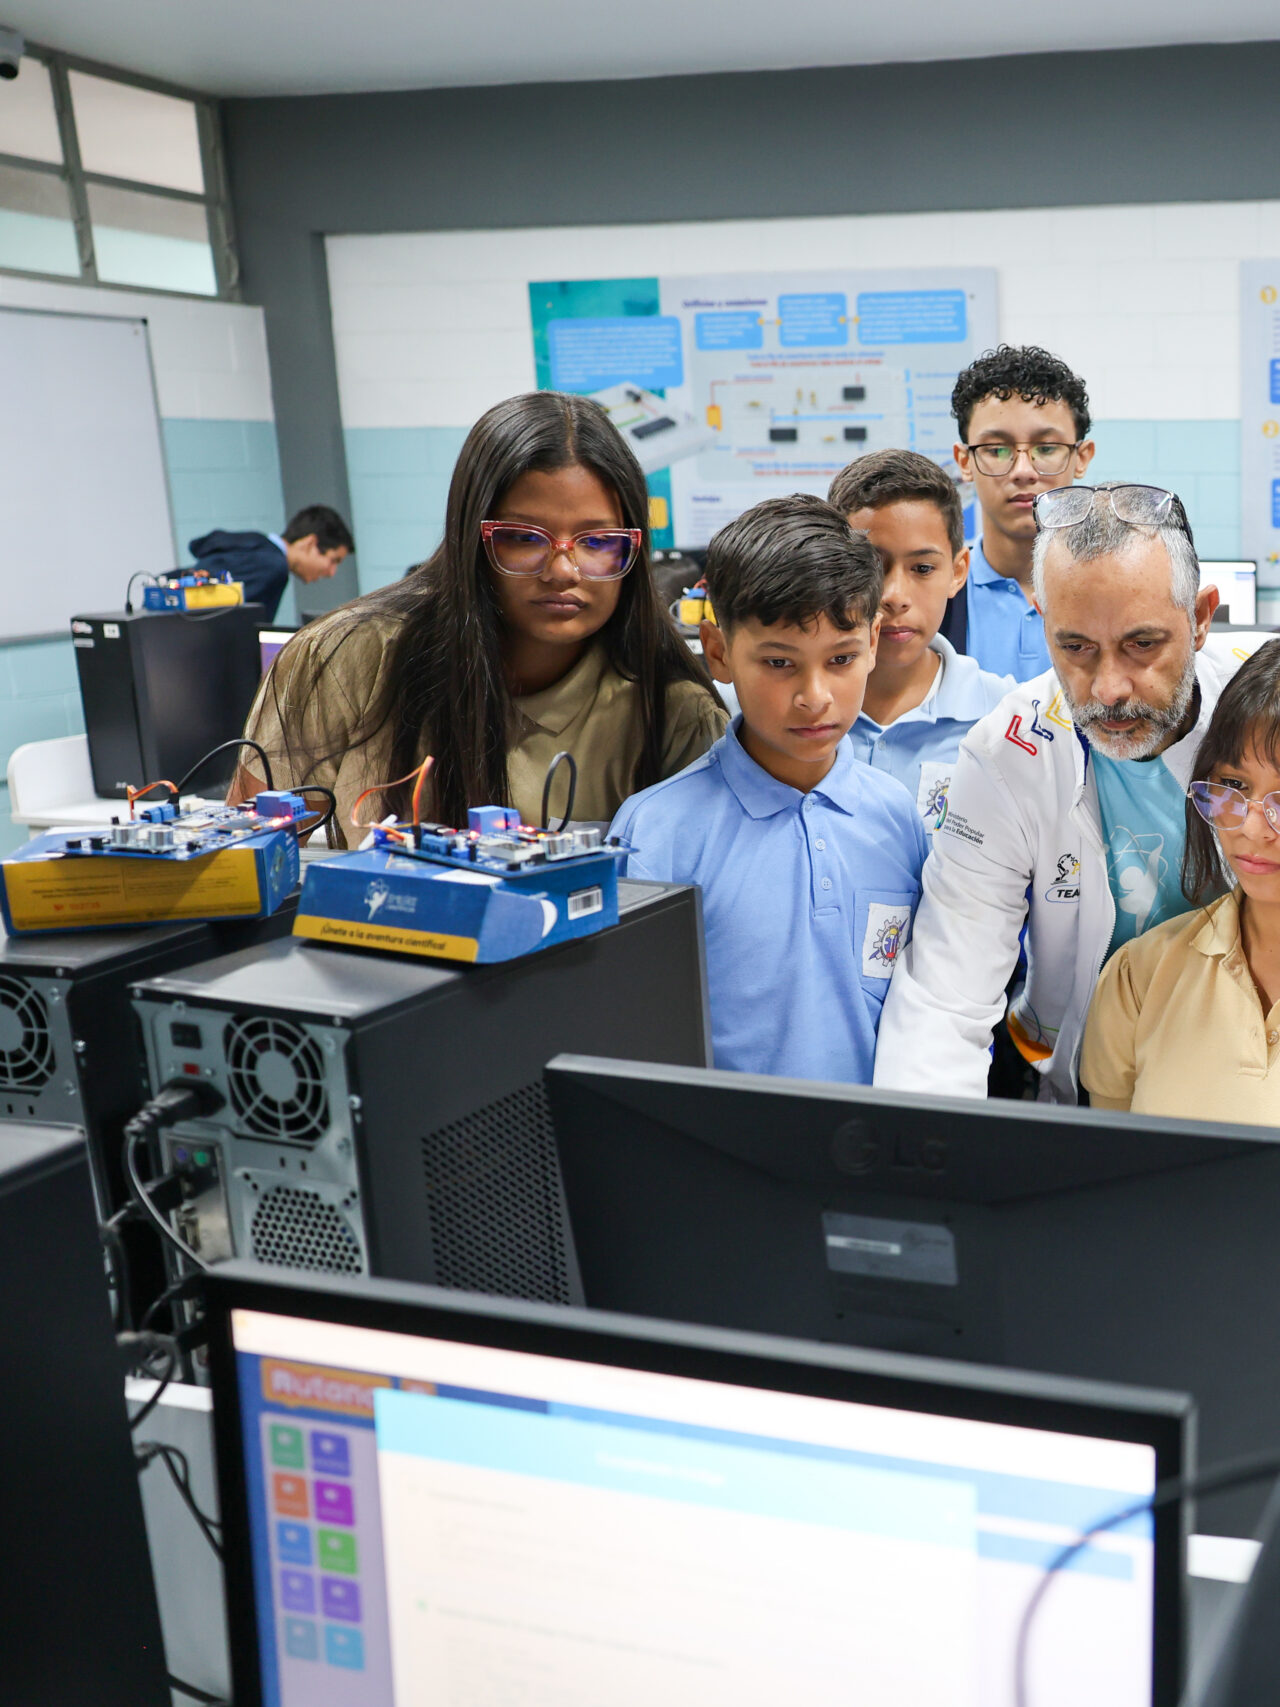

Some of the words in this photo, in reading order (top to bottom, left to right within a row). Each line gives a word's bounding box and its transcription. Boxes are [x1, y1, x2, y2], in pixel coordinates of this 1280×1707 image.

[956, 828, 984, 845] Educación
[964, 824, 985, 838] Popular
[366, 932, 404, 946] aventura
